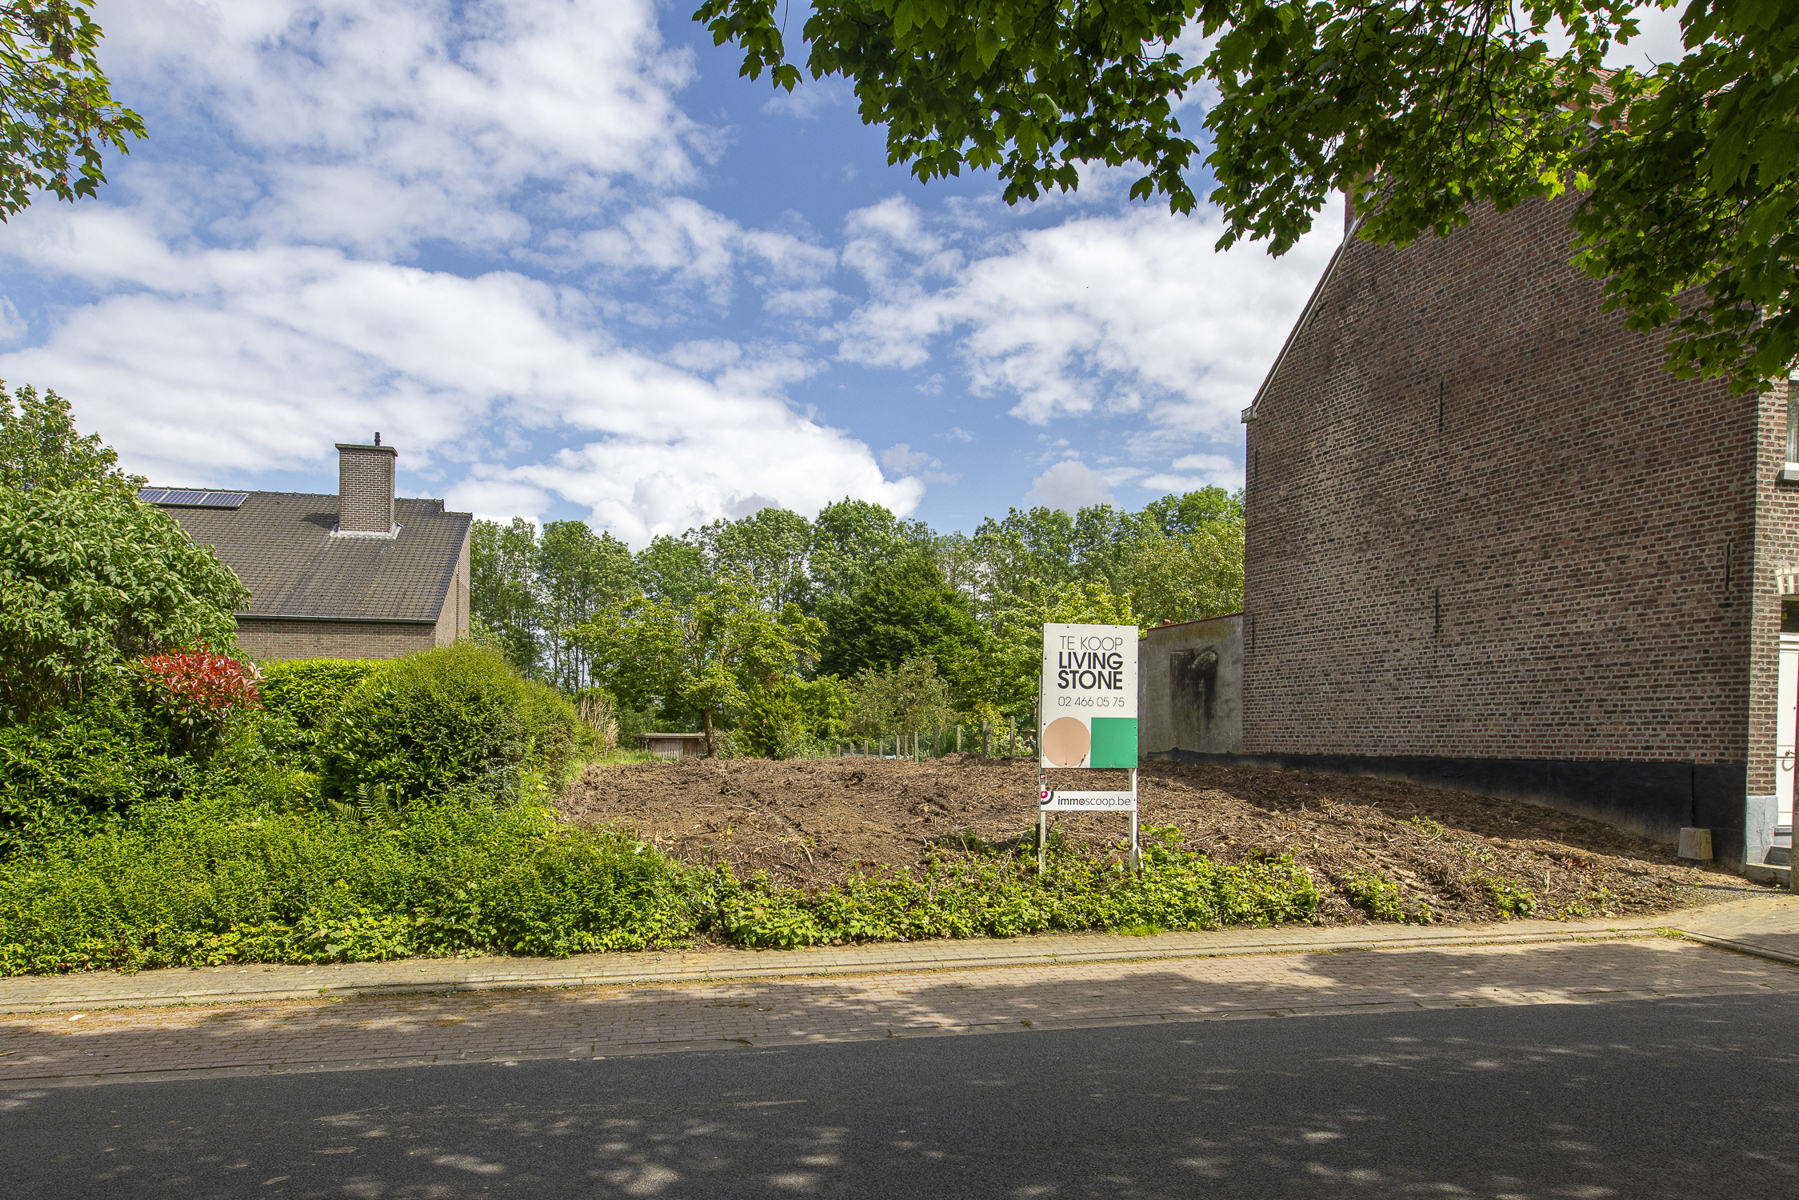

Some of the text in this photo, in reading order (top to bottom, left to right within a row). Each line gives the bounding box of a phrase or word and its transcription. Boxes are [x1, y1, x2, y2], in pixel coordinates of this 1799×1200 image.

[1059, 635, 1124, 651] TE KOOP
[1058, 651, 1124, 670] LIVING
[1057, 670, 1123, 690] STONE
[1058, 696, 1125, 707] 02 466 05 75
[1057, 796, 1131, 807] immoscoop.be
